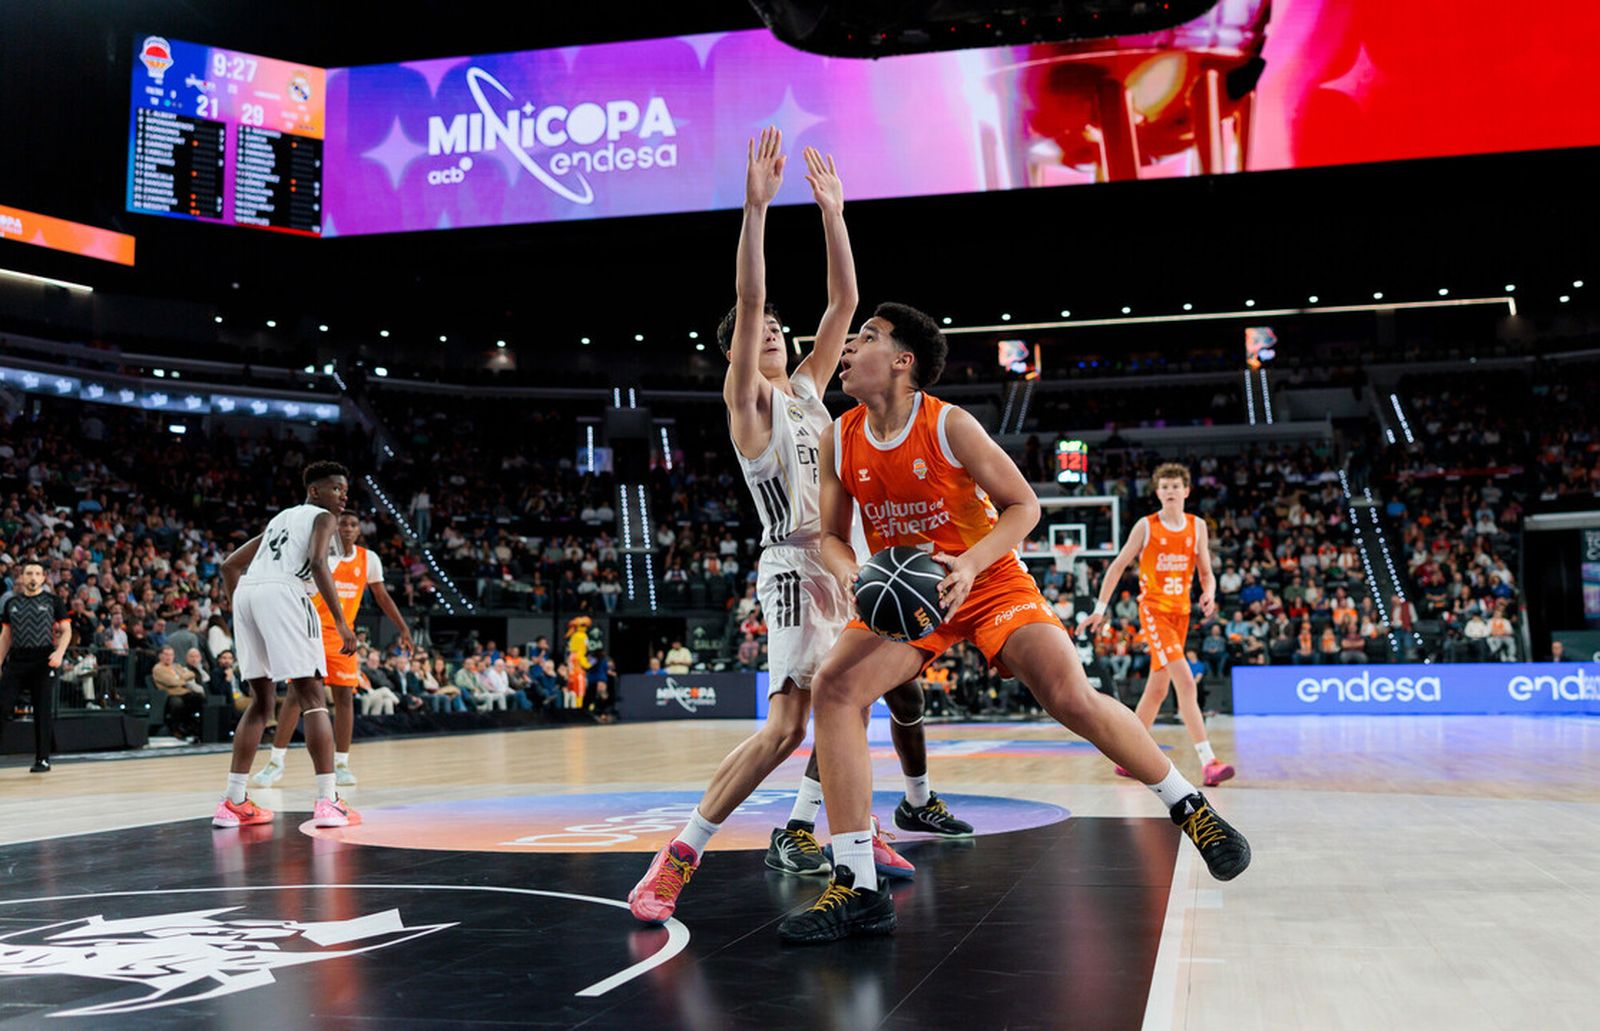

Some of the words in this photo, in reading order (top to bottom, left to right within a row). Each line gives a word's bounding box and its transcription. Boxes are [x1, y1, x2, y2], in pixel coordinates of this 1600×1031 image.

[213, 53, 257, 82] 9:27
[196, 94, 219, 119] 21
[241, 102, 264, 126] 29
[550, 143, 677, 175] endesa
[428, 160, 470, 185] acb
[864, 500, 928, 520] Cultura
[1296, 671, 1441, 703] endesa
